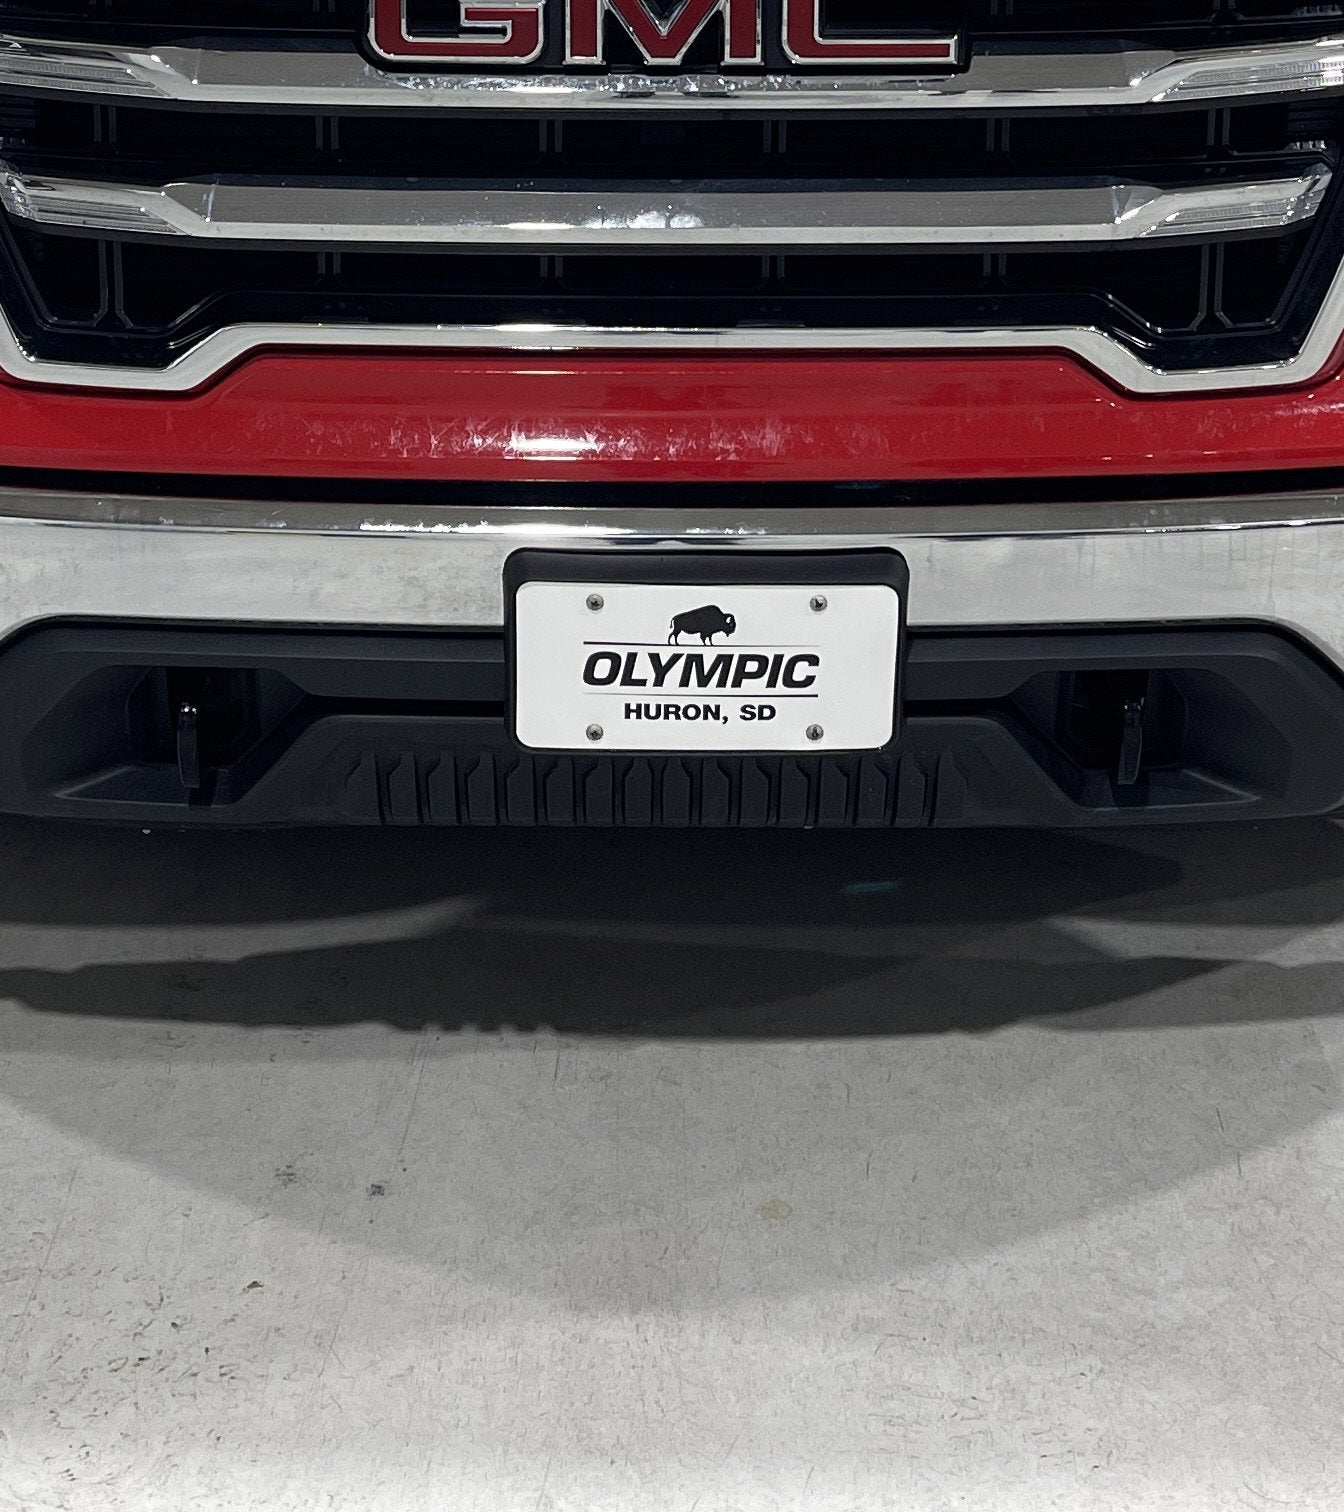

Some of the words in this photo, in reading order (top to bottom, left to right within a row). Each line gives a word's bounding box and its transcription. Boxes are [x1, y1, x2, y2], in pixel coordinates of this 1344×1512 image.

[582, 650, 820, 689] OLYMPIC
[624, 703, 729, 724] HURON,
[739, 704, 776, 721] SD
